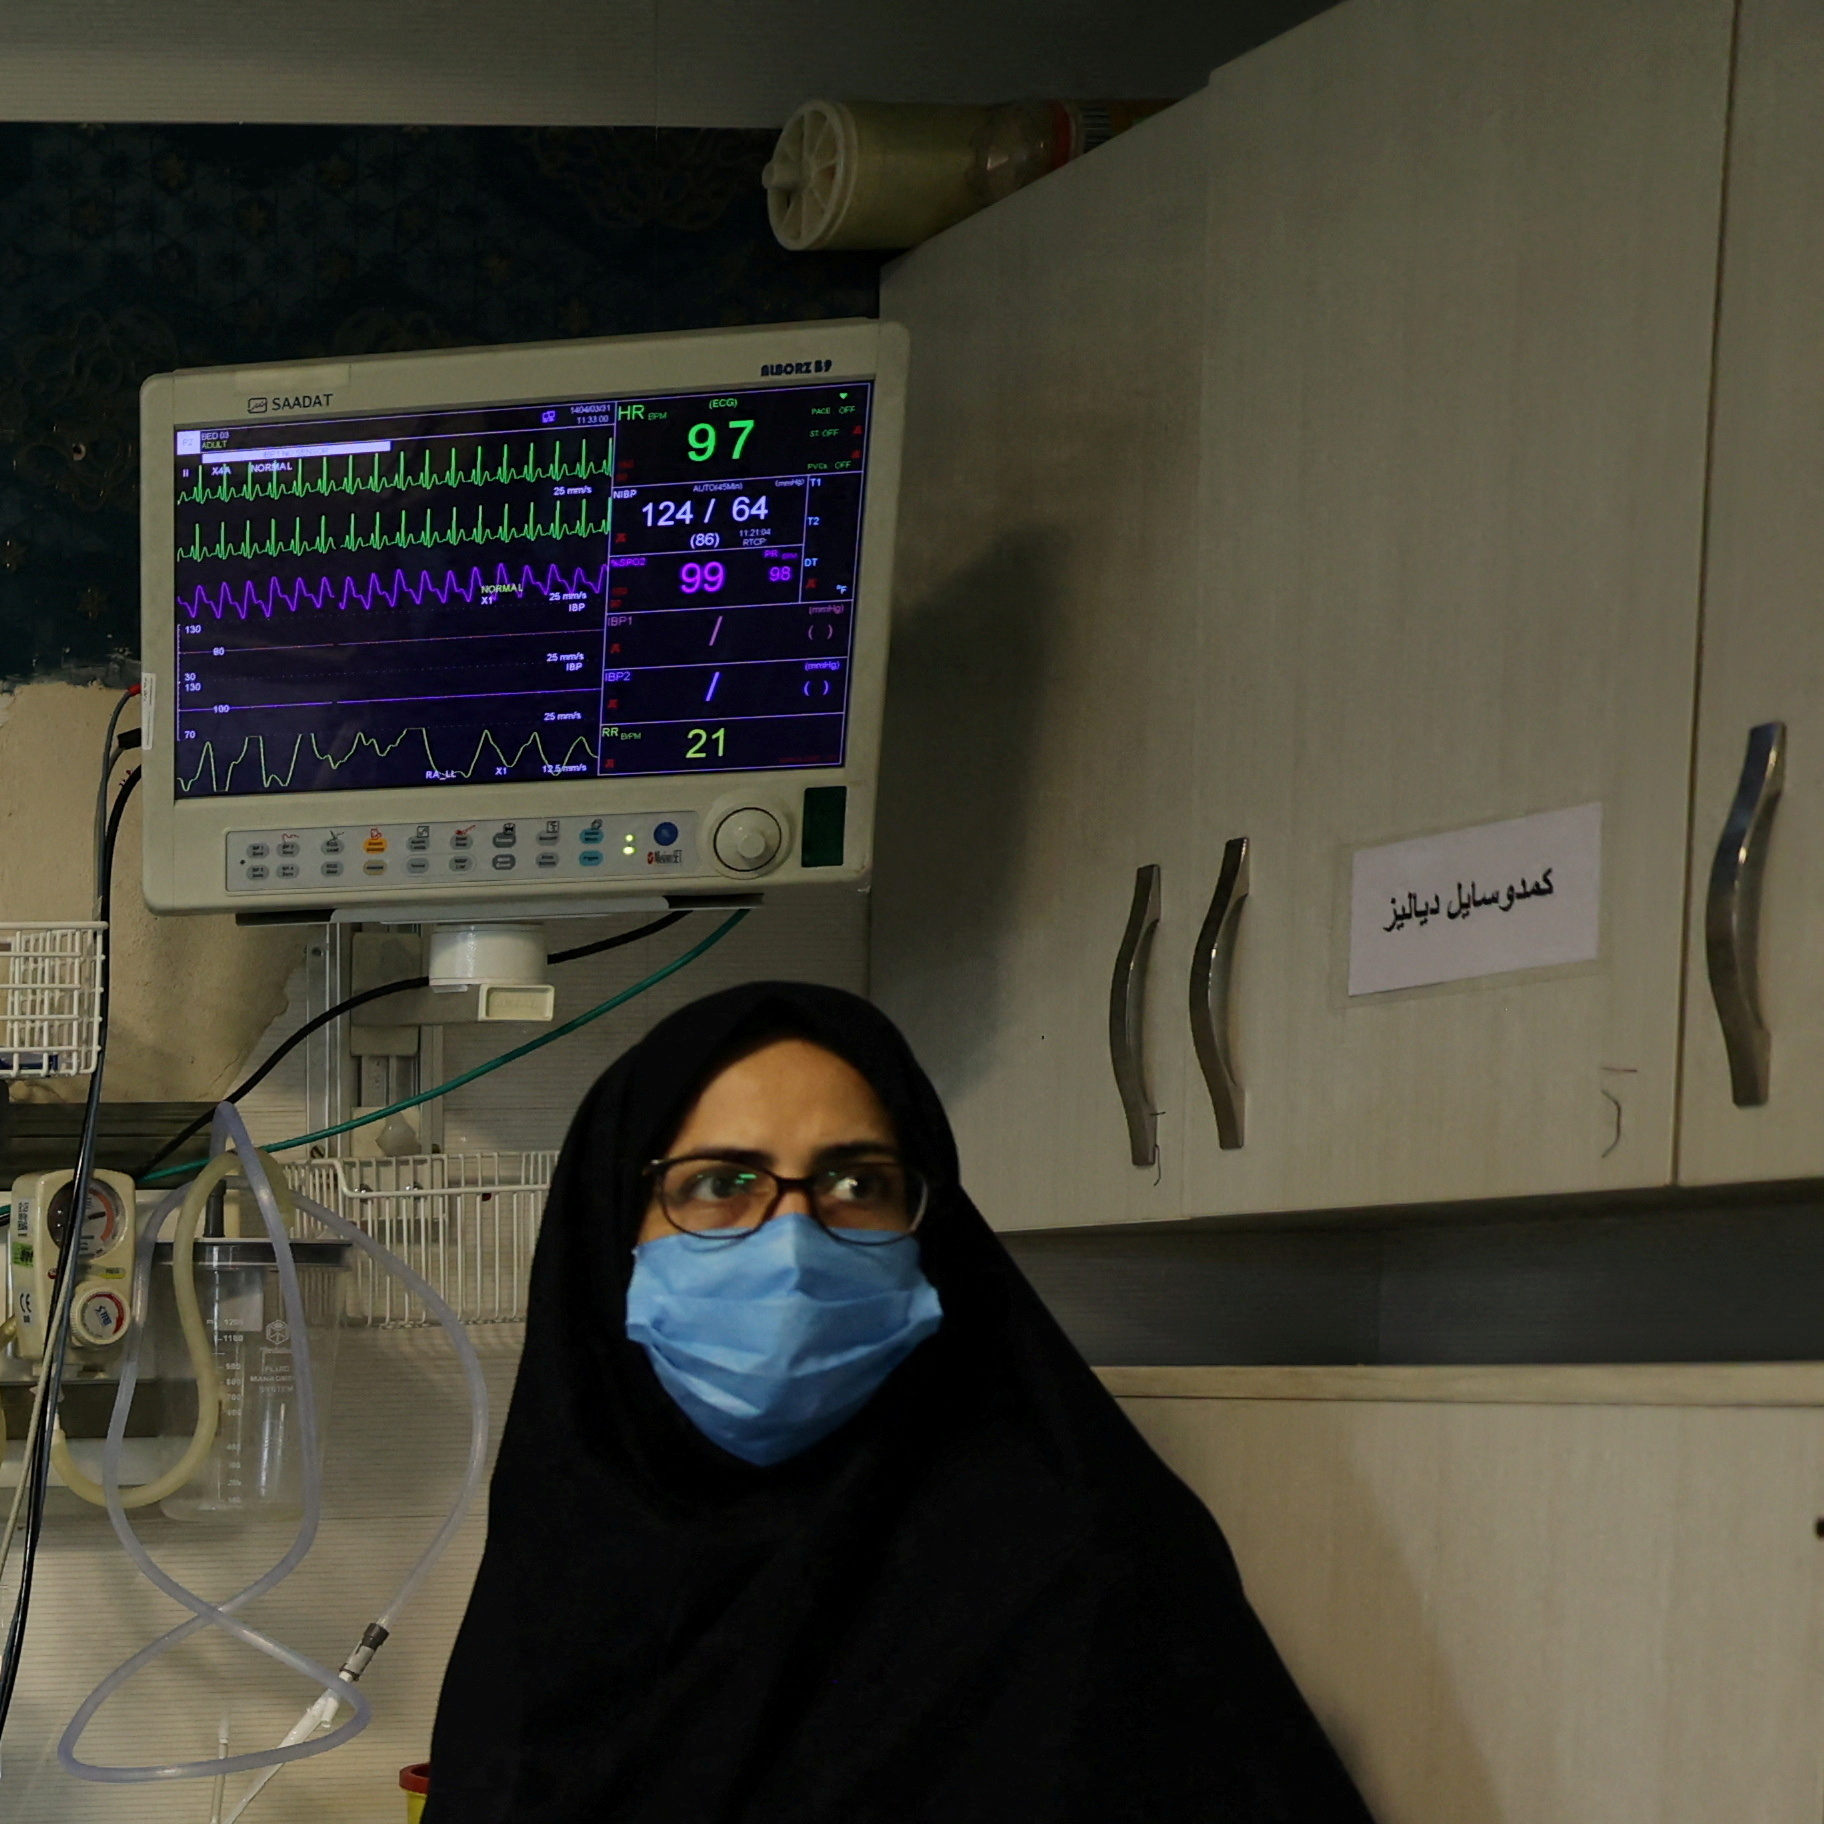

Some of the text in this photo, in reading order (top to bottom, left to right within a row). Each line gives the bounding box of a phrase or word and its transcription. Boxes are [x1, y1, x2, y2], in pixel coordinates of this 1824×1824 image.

[761, 359, 832, 377] ALBORZ B9
[271, 393, 334, 411] SAADAT
[709, 398, 738, 410] (ECG)
[618, 404, 645, 422] HR
[839, 405, 856, 415] OFF
[202, 431, 219, 441] BED
[822, 428, 840, 437] OFF
[202, 440, 228, 449] ADULT
[688, 419, 754, 462] 97
[250, 463, 293, 474] NORMAL
[834, 460, 852, 470] OFF
[810, 478, 822, 487] T1
[553, 485, 593, 496] 25 mm/s
[613, 489, 638, 500] NIBP
[642, 500, 694, 527] 124
[731, 495, 769, 523] 64
[807, 516, 820, 526] T2
[690, 532, 720, 550] (86)
[763, 549, 778, 559] PR
[610, 557, 647, 569] %SPO2
[804, 558, 819, 568] DT
[679, 561, 792, 594] 99 98
[481, 583, 524, 594] NORMAL
[481, 596, 494, 605] X1
[549, 591, 587, 602] 25 mm/s
[568, 602, 586, 612] IBP
[607, 604, 844, 627] IBP1 (mmHg)
[184, 625, 202, 634] 130
[546, 652, 585, 662] 25 mm/s
[565, 662, 583, 671] IBP
[604, 661, 840, 682] IBP2 (mmHg)
[184, 673, 197, 682] 30
[184, 683, 202, 692] 130
[213, 704, 231, 714] 100
[544, 711, 582, 721] 25 mm/s
[184, 730, 196, 739] 70
[602, 726, 619, 738] RR
[685, 727, 726, 759] 21
[495, 766, 507, 776] X1
[1383, 891, 1440, 933] دیالیز
[265, 1365, 290, 1373] FLUID
[258, 1386, 295, 1394] SYSTEM
